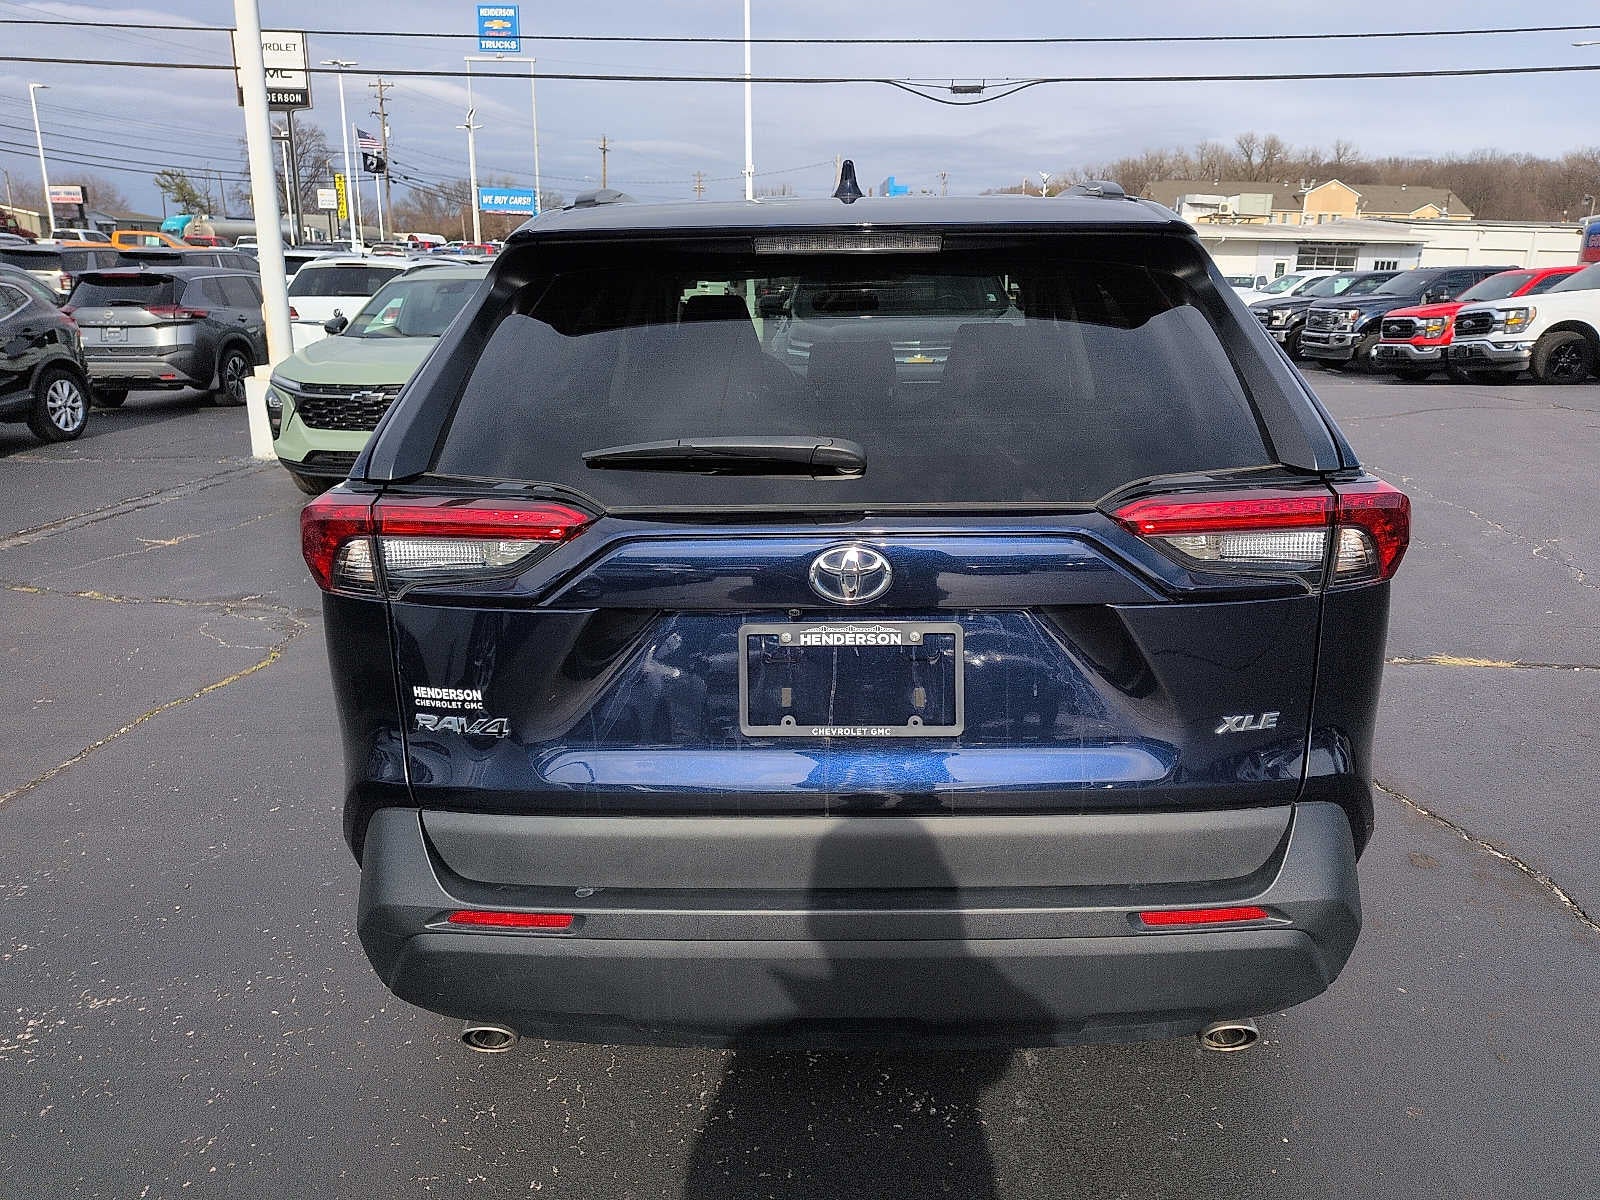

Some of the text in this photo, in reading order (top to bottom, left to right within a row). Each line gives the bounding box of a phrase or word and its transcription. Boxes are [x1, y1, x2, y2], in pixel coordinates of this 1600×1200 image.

[479, 8, 515, 17] HENDERSON
[261, 43, 297, 52] VROLET
[481, 40, 517, 49] TRUCKS
[266, 93, 302, 103] DERSON
[482, 195, 494, 204] WE
[493, 195, 508, 205] BUY
[800, 633, 902, 646] HENDERSON
[412, 685, 483, 701] HENDERSON
[415, 698, 484, 710] CHEVROLET GMC
[413, 713, 510, 738] RAV4
[1214, 711, 1281, 735] XLE
[811, 727, 892, 736] CHEVROLET GMC
